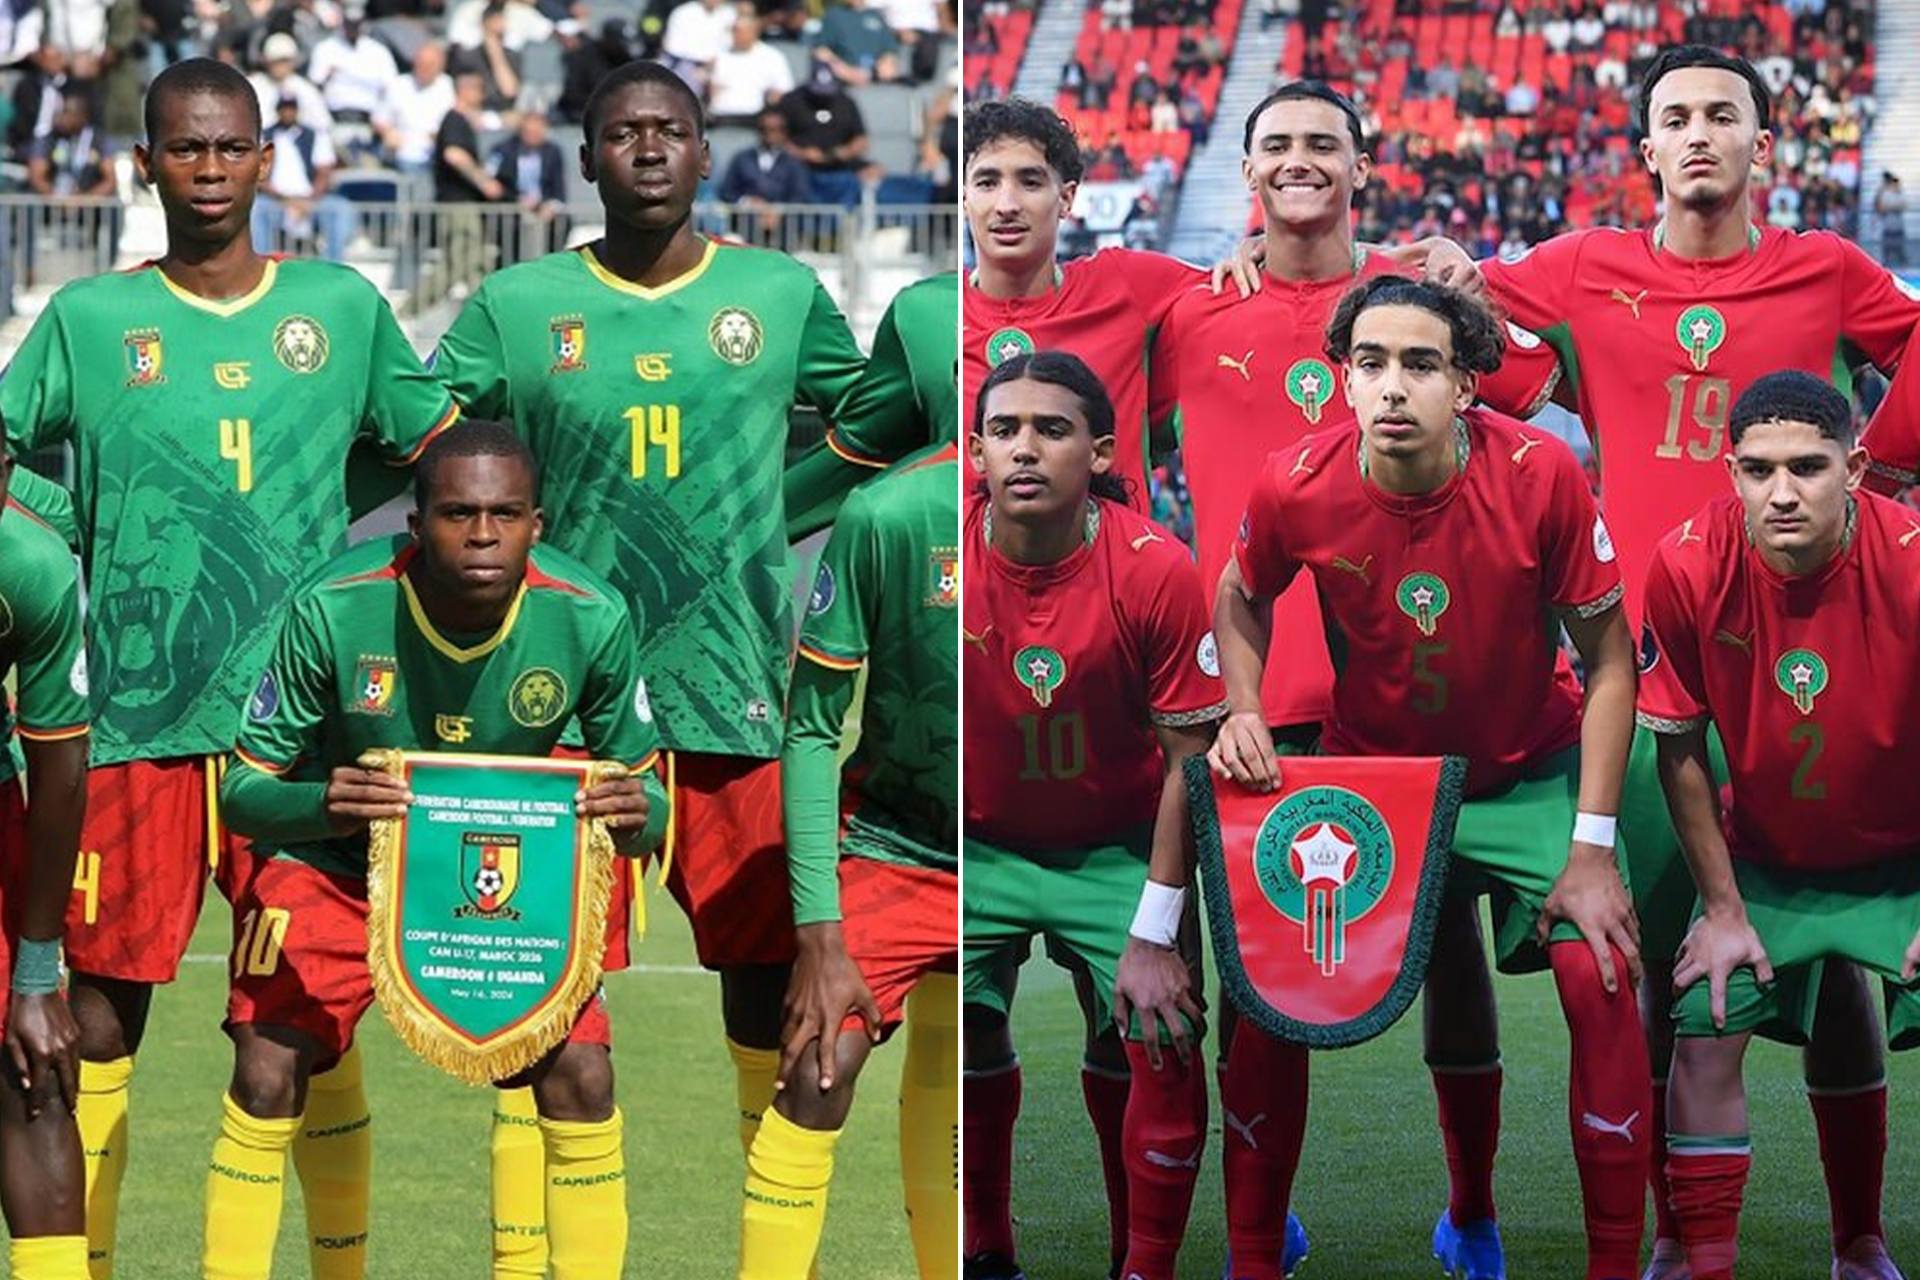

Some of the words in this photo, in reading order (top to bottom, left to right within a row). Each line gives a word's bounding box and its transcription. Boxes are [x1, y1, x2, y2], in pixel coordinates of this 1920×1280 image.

[218, 418, 252, 492] 4
[622, 404, 681, 479] 14
[1654, 375, 1731, 461] 19
[1411, 642, 1449, 717] 5
[1016, 713, 1085, 781] 10
[1789, 720, 1827, 800] 2
[73, 851, 101, 925] 4
[235, 907, 290, 979] 10
[421, 965, 486, 982] CAMEROON
[496, 970, 546, 985] UGANDA
[479, 951, 517, 963] MAROC
[494, 936, 513, 948] DES
